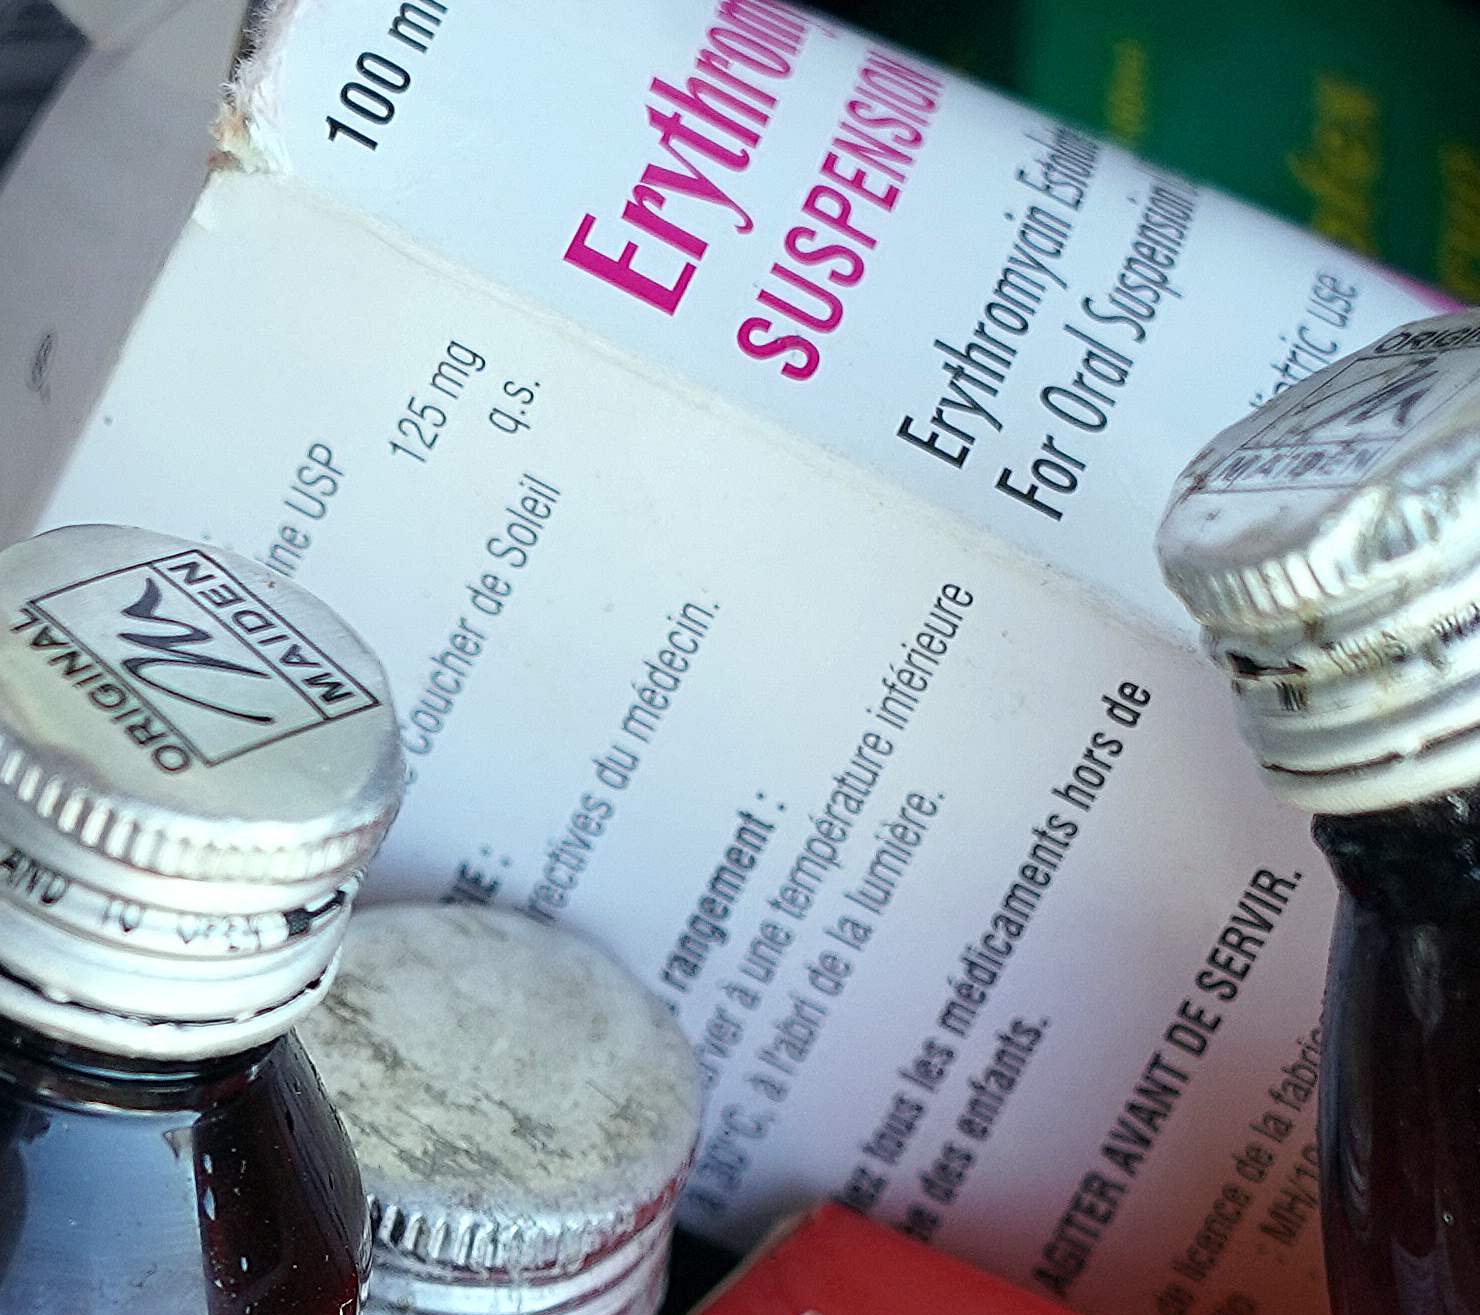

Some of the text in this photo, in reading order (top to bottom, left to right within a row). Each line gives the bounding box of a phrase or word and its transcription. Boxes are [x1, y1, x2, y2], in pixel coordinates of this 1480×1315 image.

[324, 64, 415, 155] 100
[736, 44, 949, 385] SUSPENSION
[389, 339, 487, 463] 125 mg
[898, 205, 1072, 470] Erythromycin
[995, 323, 1134, 521] For Oral
[284, 440, 349, 528] USP
[8, 602, 194, 774] ORIGINAL
[170, 558, 358, 713] MAIDEN
[384, 472, 561, 762] Coucher Soleil
[866, 582, 975, 731] inférieure
[652, 804, 776, 994] rangement
[939, 681, 1151, 1045] médicaments hors de
[1093, 868, 1303, 1177] AVANT SERVIR.
